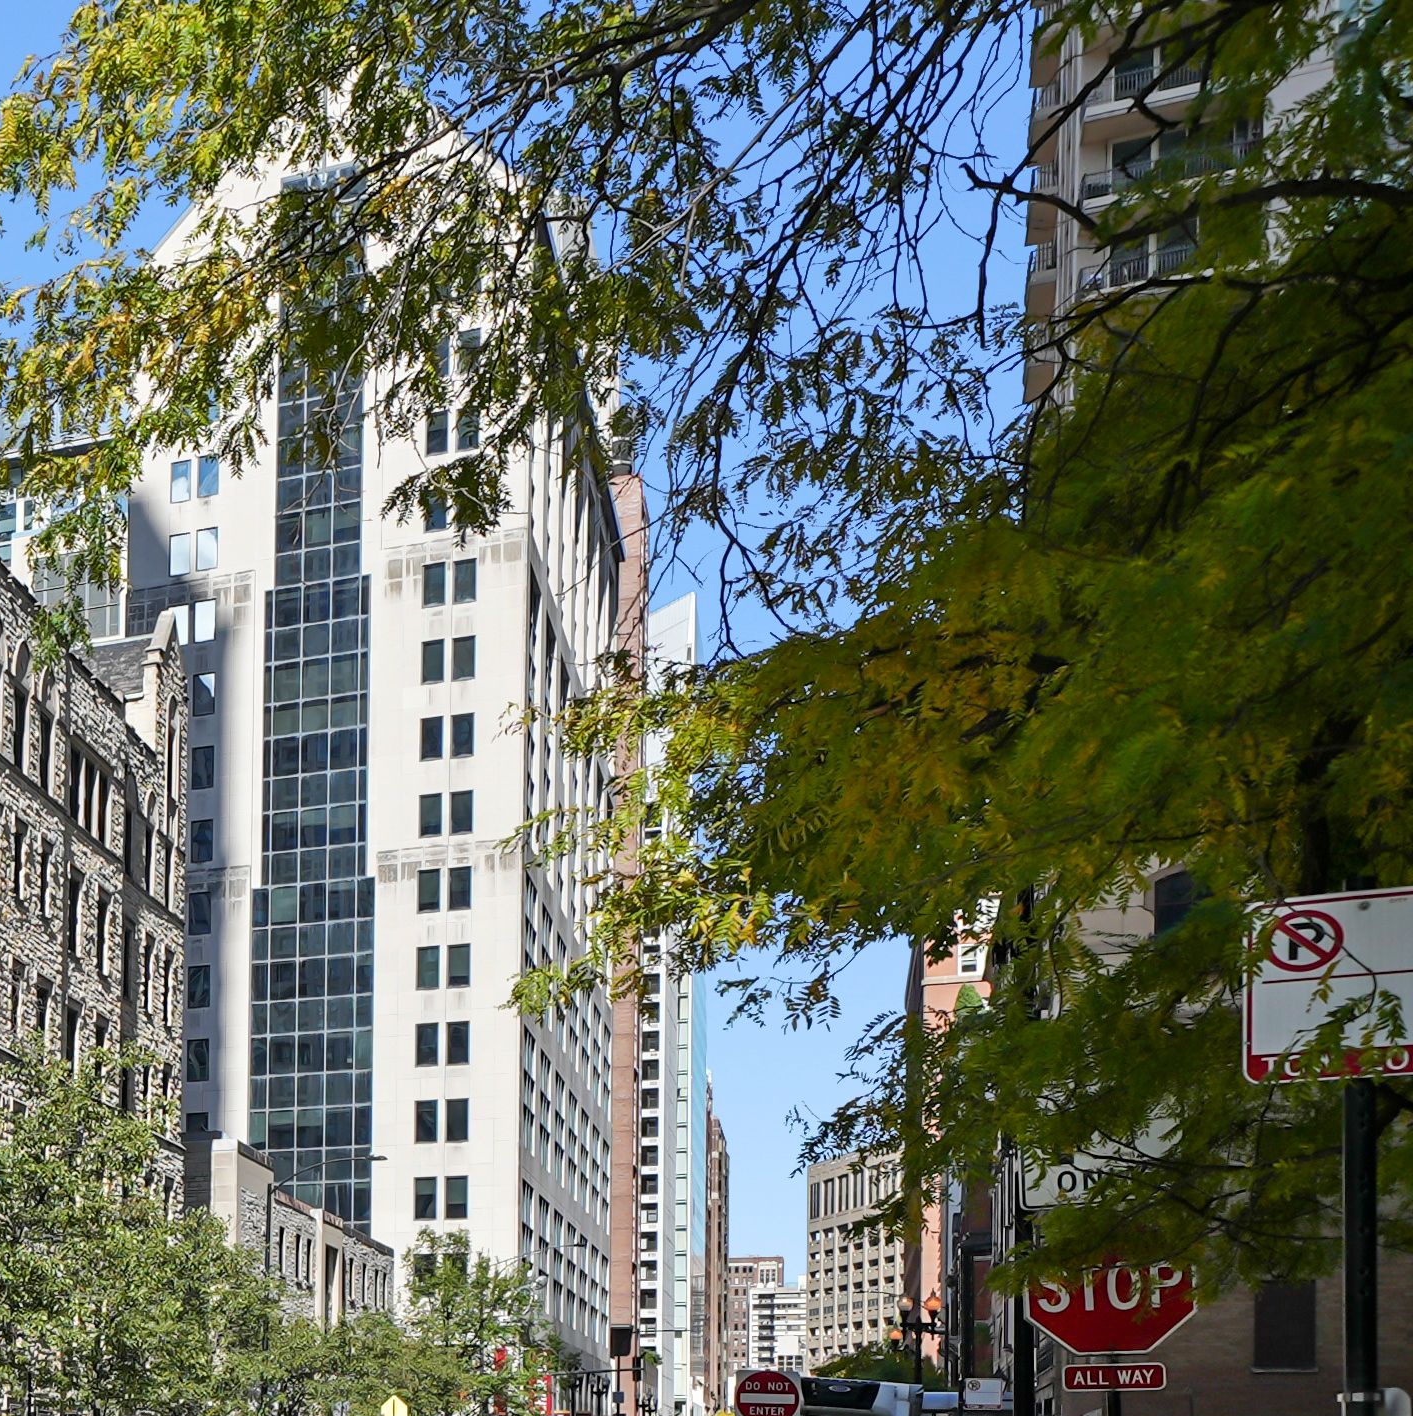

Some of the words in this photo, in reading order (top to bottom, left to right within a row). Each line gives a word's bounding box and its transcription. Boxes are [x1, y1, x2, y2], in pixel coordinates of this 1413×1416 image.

[1037, 1260, 1183, 1314] STOP
[1073, 1370, 1109, 1386] ALL
[1117, 1368, 1155, 1386] WAY
[745, 1381, 761, 1391] DO
[767, 1381, 791, 1391] NOT
[749, 1406, 786, 1416] ENTER
